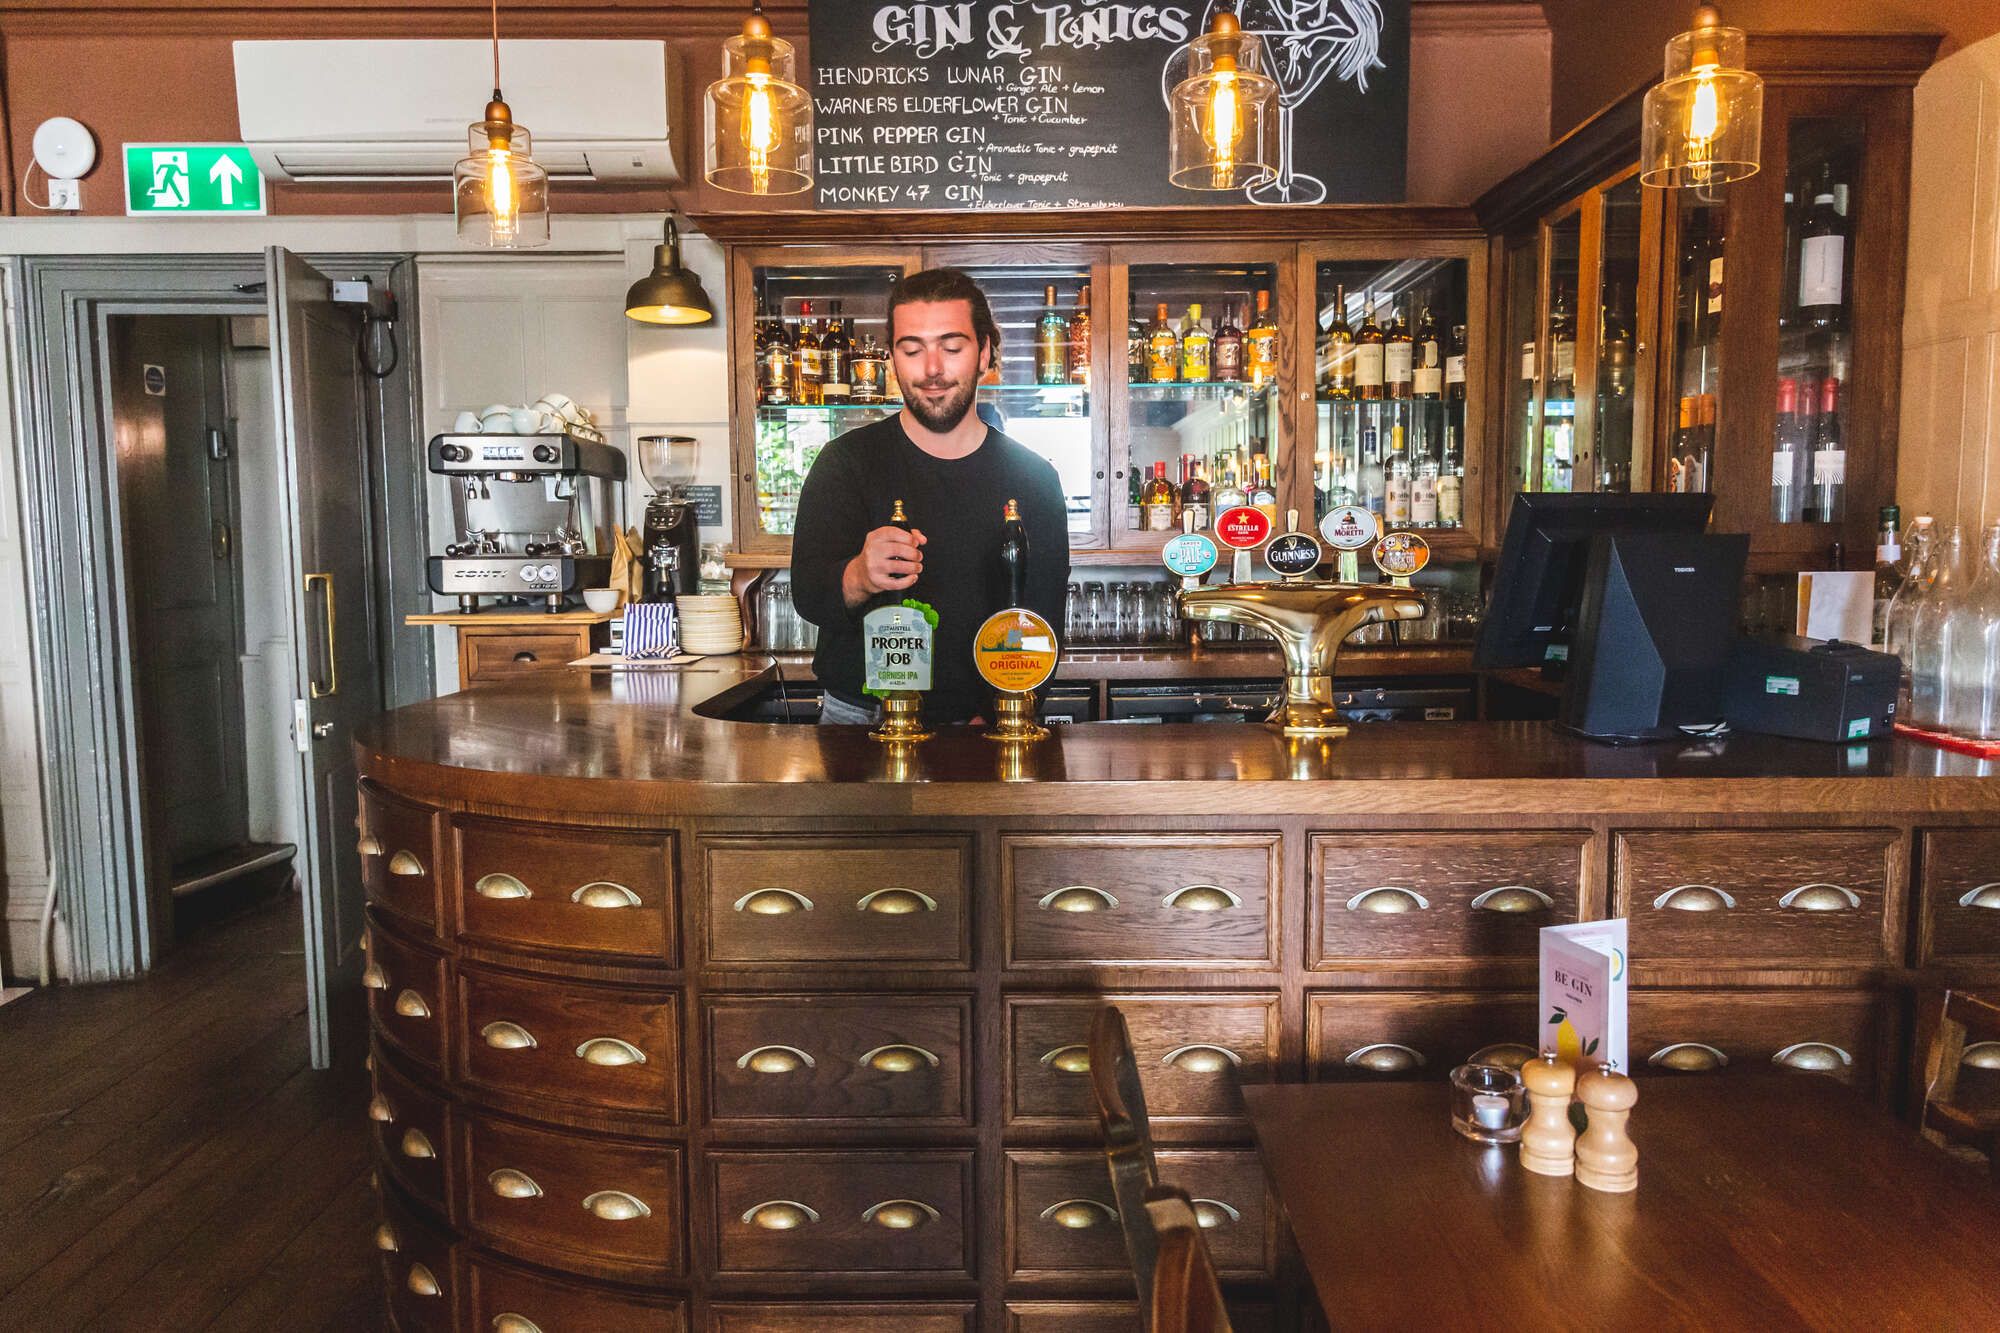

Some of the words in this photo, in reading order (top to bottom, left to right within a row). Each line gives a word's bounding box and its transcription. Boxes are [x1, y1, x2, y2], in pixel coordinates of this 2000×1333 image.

[872, 1, 976, 59] GIN
[986, 4, 1032, 64] &
[818, 67, 929, 85] HENDRICK'S
[947, 66, 1005, 84] LUNAR
[1019, 66, 1062, 86] GIN
[1006, 83, 1036, 96] Ginger
[1040, 84, 1058, 94] Ale
[815, 97, 898, 115] WARNER'S
[903, 96, 1018, 114] ELDERFLOWER
[1025, 97, 1068, 114] GIN
[1002, 114, 1028, 123] Tonic
[817, 127, 864, 145] PINK
[873, 126, 938, 144] PEPPER
[946, 127, 985, 144] GIN
[985, 143, 1031, 154] Aromatic
[1034, 143, 1056, 154] Tonic
[819, 156, 885, 174] LITTLE
[890, 155, 939, 174] BIRD
[948, 155, 992, 174] GIN
[980, 172, 1002, 182] Tonic
[820, 186, 900, 203] MONKEY
[906, 184, 930, 202] 47
[945, 185, 984, 201] GIN
[1227, 524, 1259, 532] ESTRELLA
[1334, 529, 1364, 537] MORETTI
[1270, 549, 1315, 562] GUINNESS
[871, 637, 925, 650] PROPER
[886, 652, 911, 667] JOB
[989, 660, 1043, 670] ORIGINAL
[907, 671, 918, 681] IPA
[1554, 970, 1569, 986] BE
[1571, 979, 1592, 997] GIN
